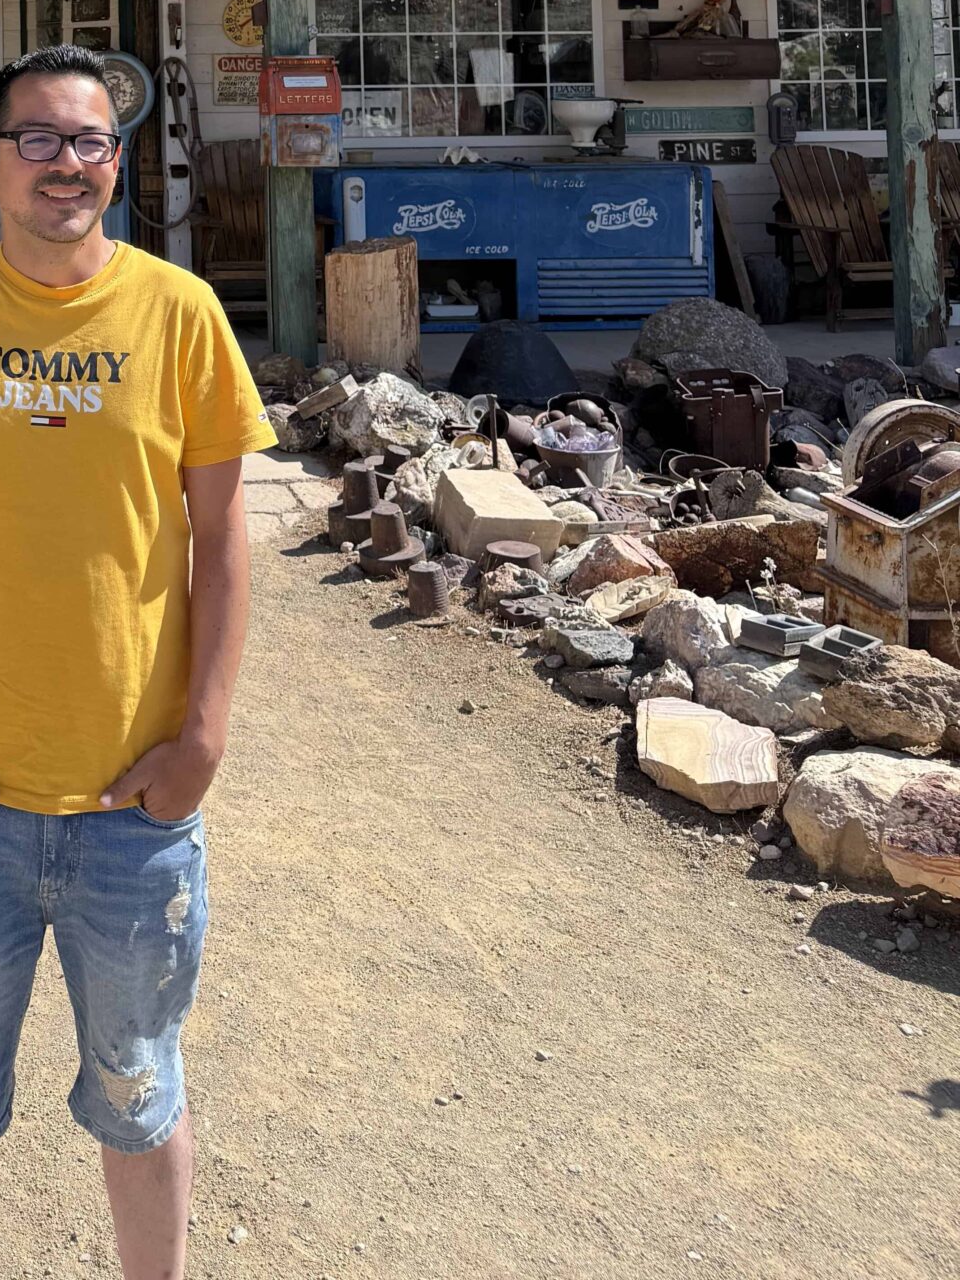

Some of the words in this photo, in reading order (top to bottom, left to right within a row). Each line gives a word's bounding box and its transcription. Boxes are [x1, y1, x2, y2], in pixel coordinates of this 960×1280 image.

[221, 59, 262, 71] DANGE
[280, 95, 333, 104] LETTERS
[342, 107, 396, 126] OPEN
[674, 142, 724, 161] PINE
[730, 146, 741, 156] ST
[465, 246, 482, 254] ICE
[484, 245, 509, 254] COLD
